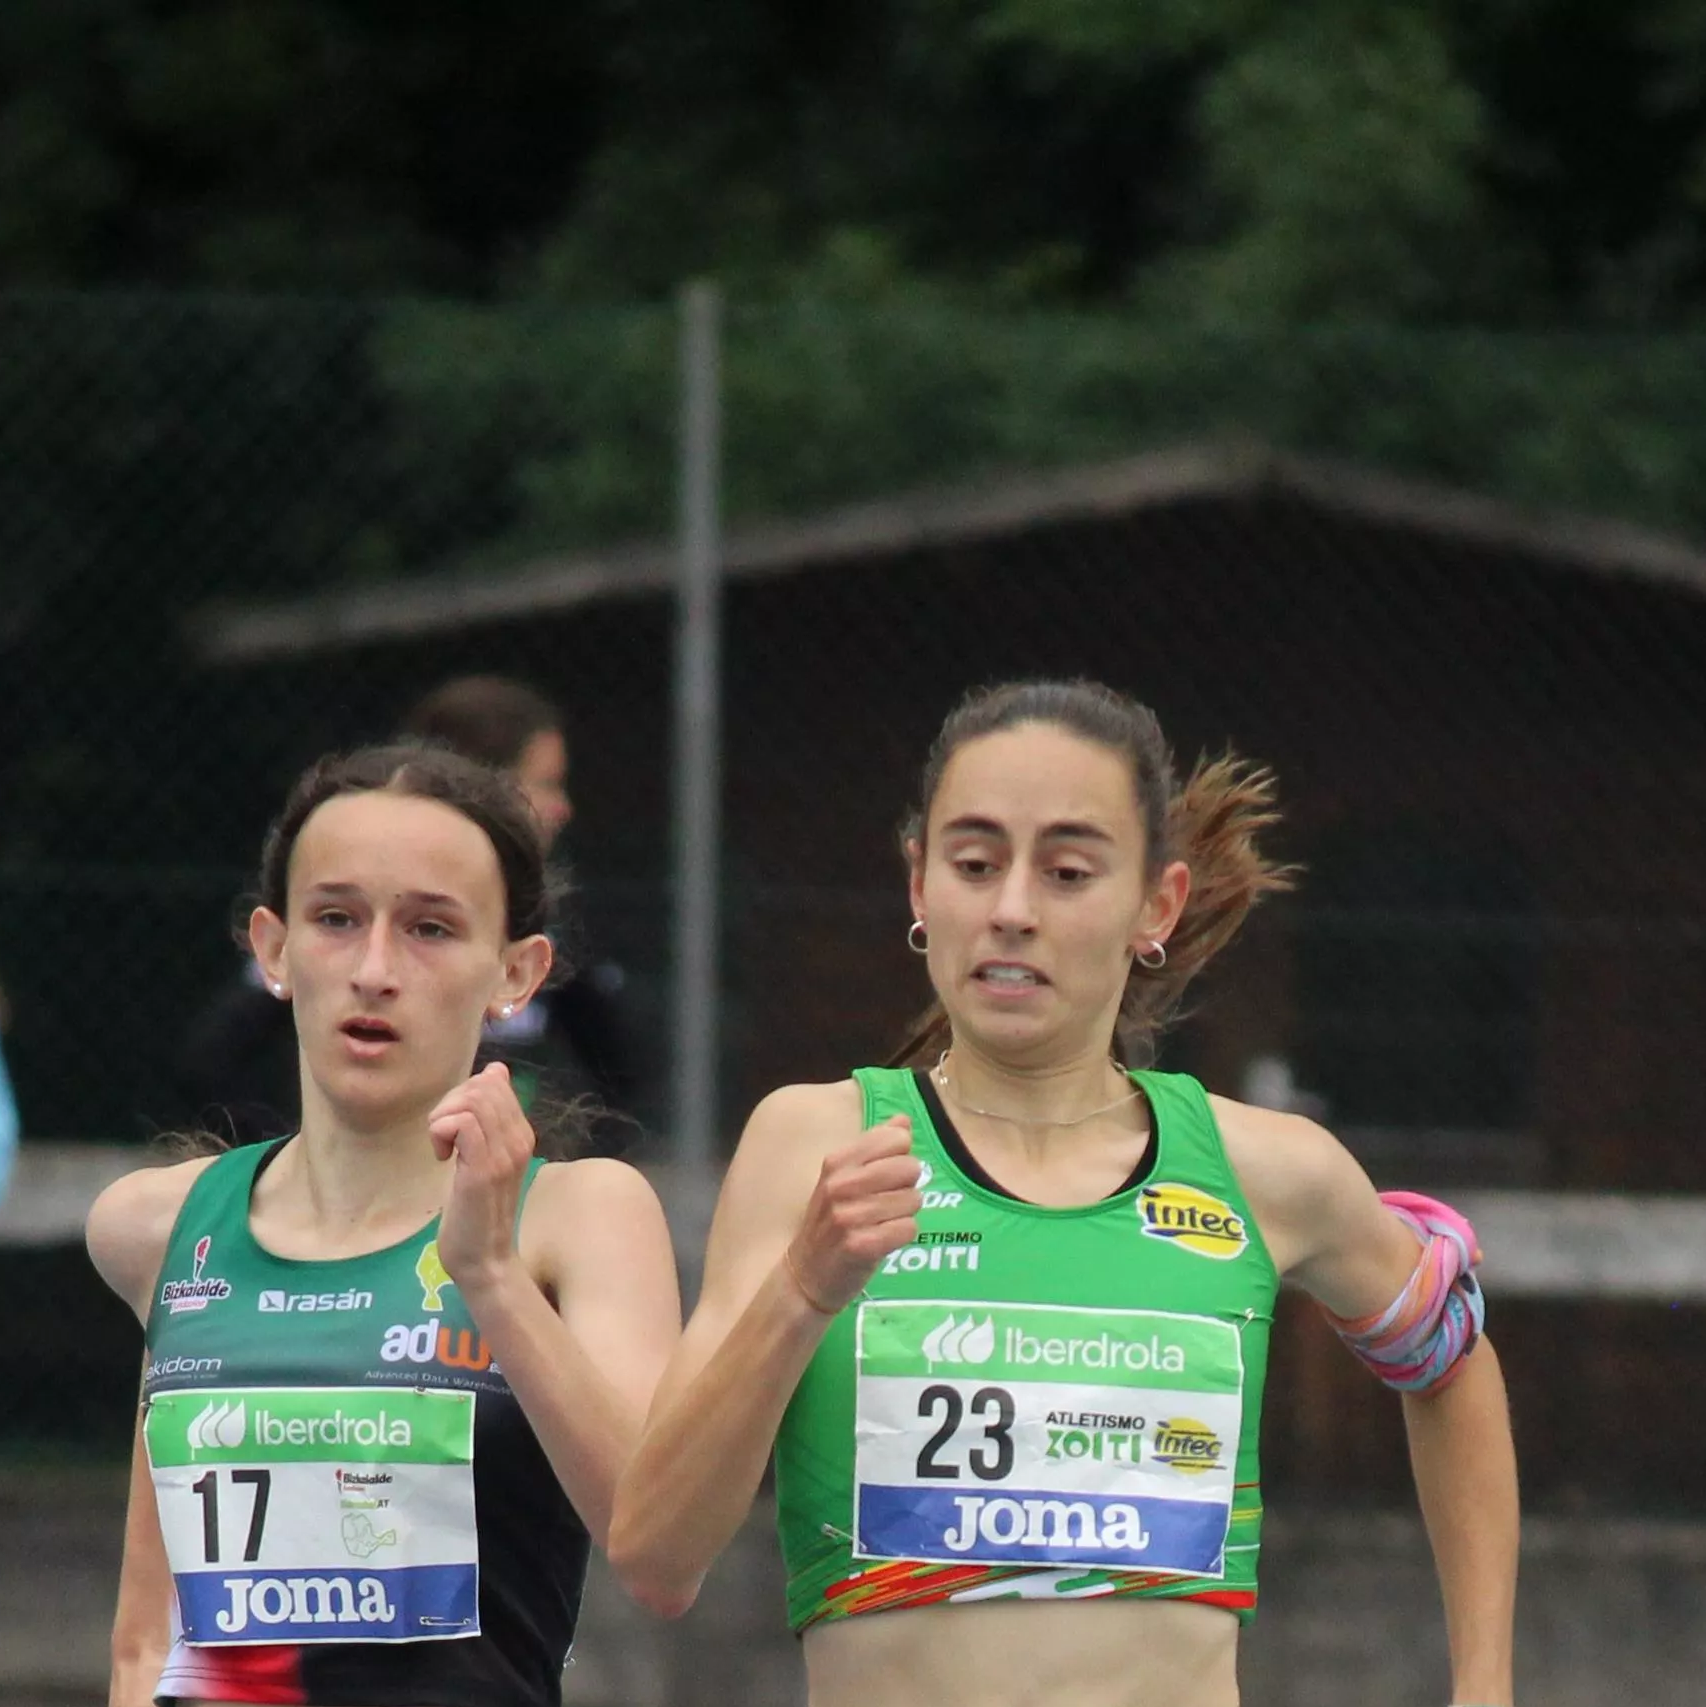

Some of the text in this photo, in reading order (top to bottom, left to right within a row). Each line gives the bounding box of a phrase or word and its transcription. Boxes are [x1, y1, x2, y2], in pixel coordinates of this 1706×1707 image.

[1142, 1187, 1243, 1237] intec
[915, 1231, 983, 1245] ETISMO
[881, 1245, 980, 1275] ZOITI
[163, 1279, 229, 1301] Bizkaialde
[1005, 1327, 1185, 1373] Iberdrola
[364, 1370, 418, 1382] Advanced
[422, 1373, 449, 1384] Data
[254, 1410, 412, 1447] Iberdrola
[915, 1384, 1016, 1481] 23
[1045, 1411, 1146, 1430] ATLETISMO
[1153, 1420, 1223, 1458] intec
[1045, 1429, 1141, 1463] ZOITI
[192, 1469, 272, 1564] 17
[943, 1496, 1150, 1551] Joma
[215, 1576, 395, 1632] Joma
